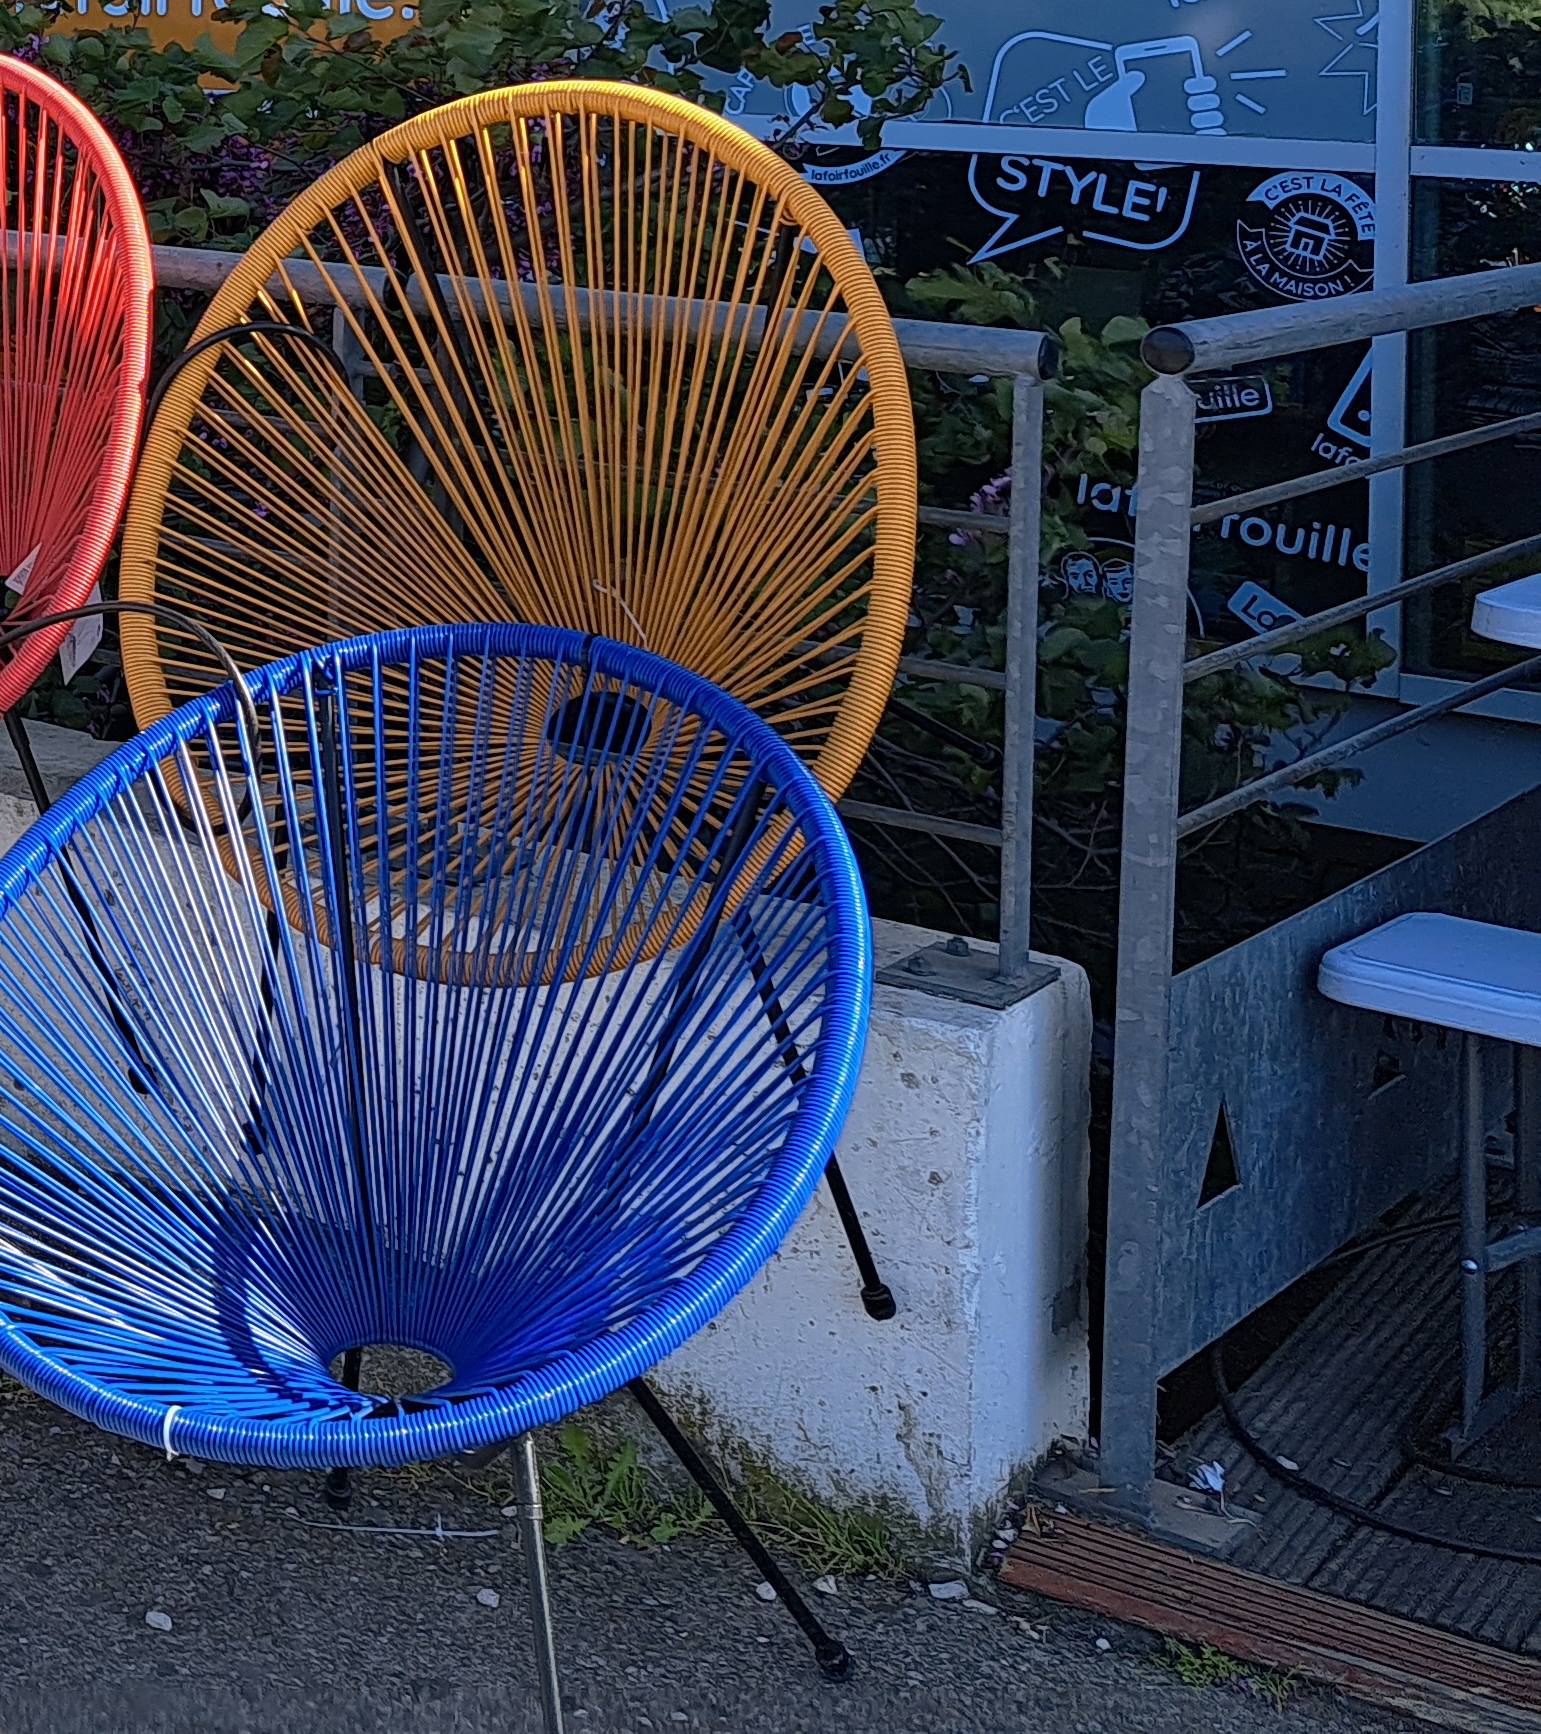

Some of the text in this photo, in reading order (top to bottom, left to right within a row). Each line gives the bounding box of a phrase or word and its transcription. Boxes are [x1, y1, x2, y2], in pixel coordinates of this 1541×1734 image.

[1073, 55, 1113, 92] LE
[811, 152, 892, 182] lafoirfouille.fr
[1264, 176, 1314, 201] C'EST
[1320, 178, 1342, 197] LA
[1250, 253, 1270, 276] LA
[1270, 272, 1344, 297] MAISON
[1196, 385, 1260, 411] uille
